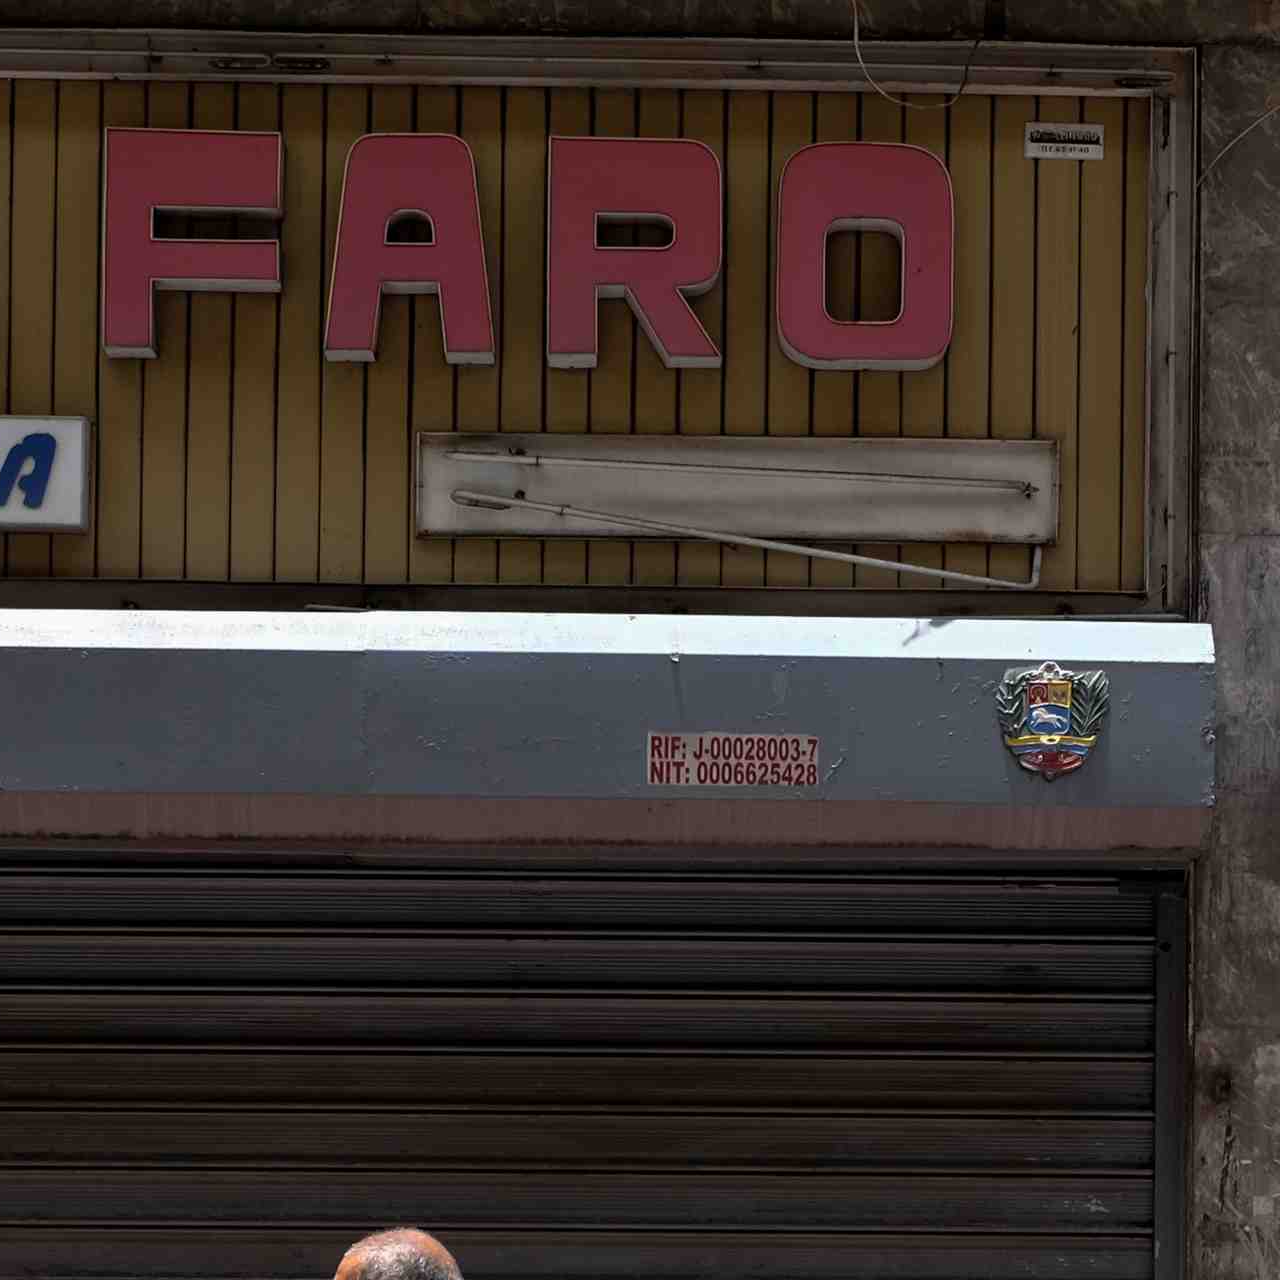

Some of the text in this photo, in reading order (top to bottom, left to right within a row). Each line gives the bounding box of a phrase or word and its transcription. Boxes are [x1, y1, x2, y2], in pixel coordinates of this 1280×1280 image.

[102, 126, 954, 370] FARO
[650, 736, 818, 762] RIF: J-00028003-7
[650, 762, 818, 785] NIT: 0006625428
